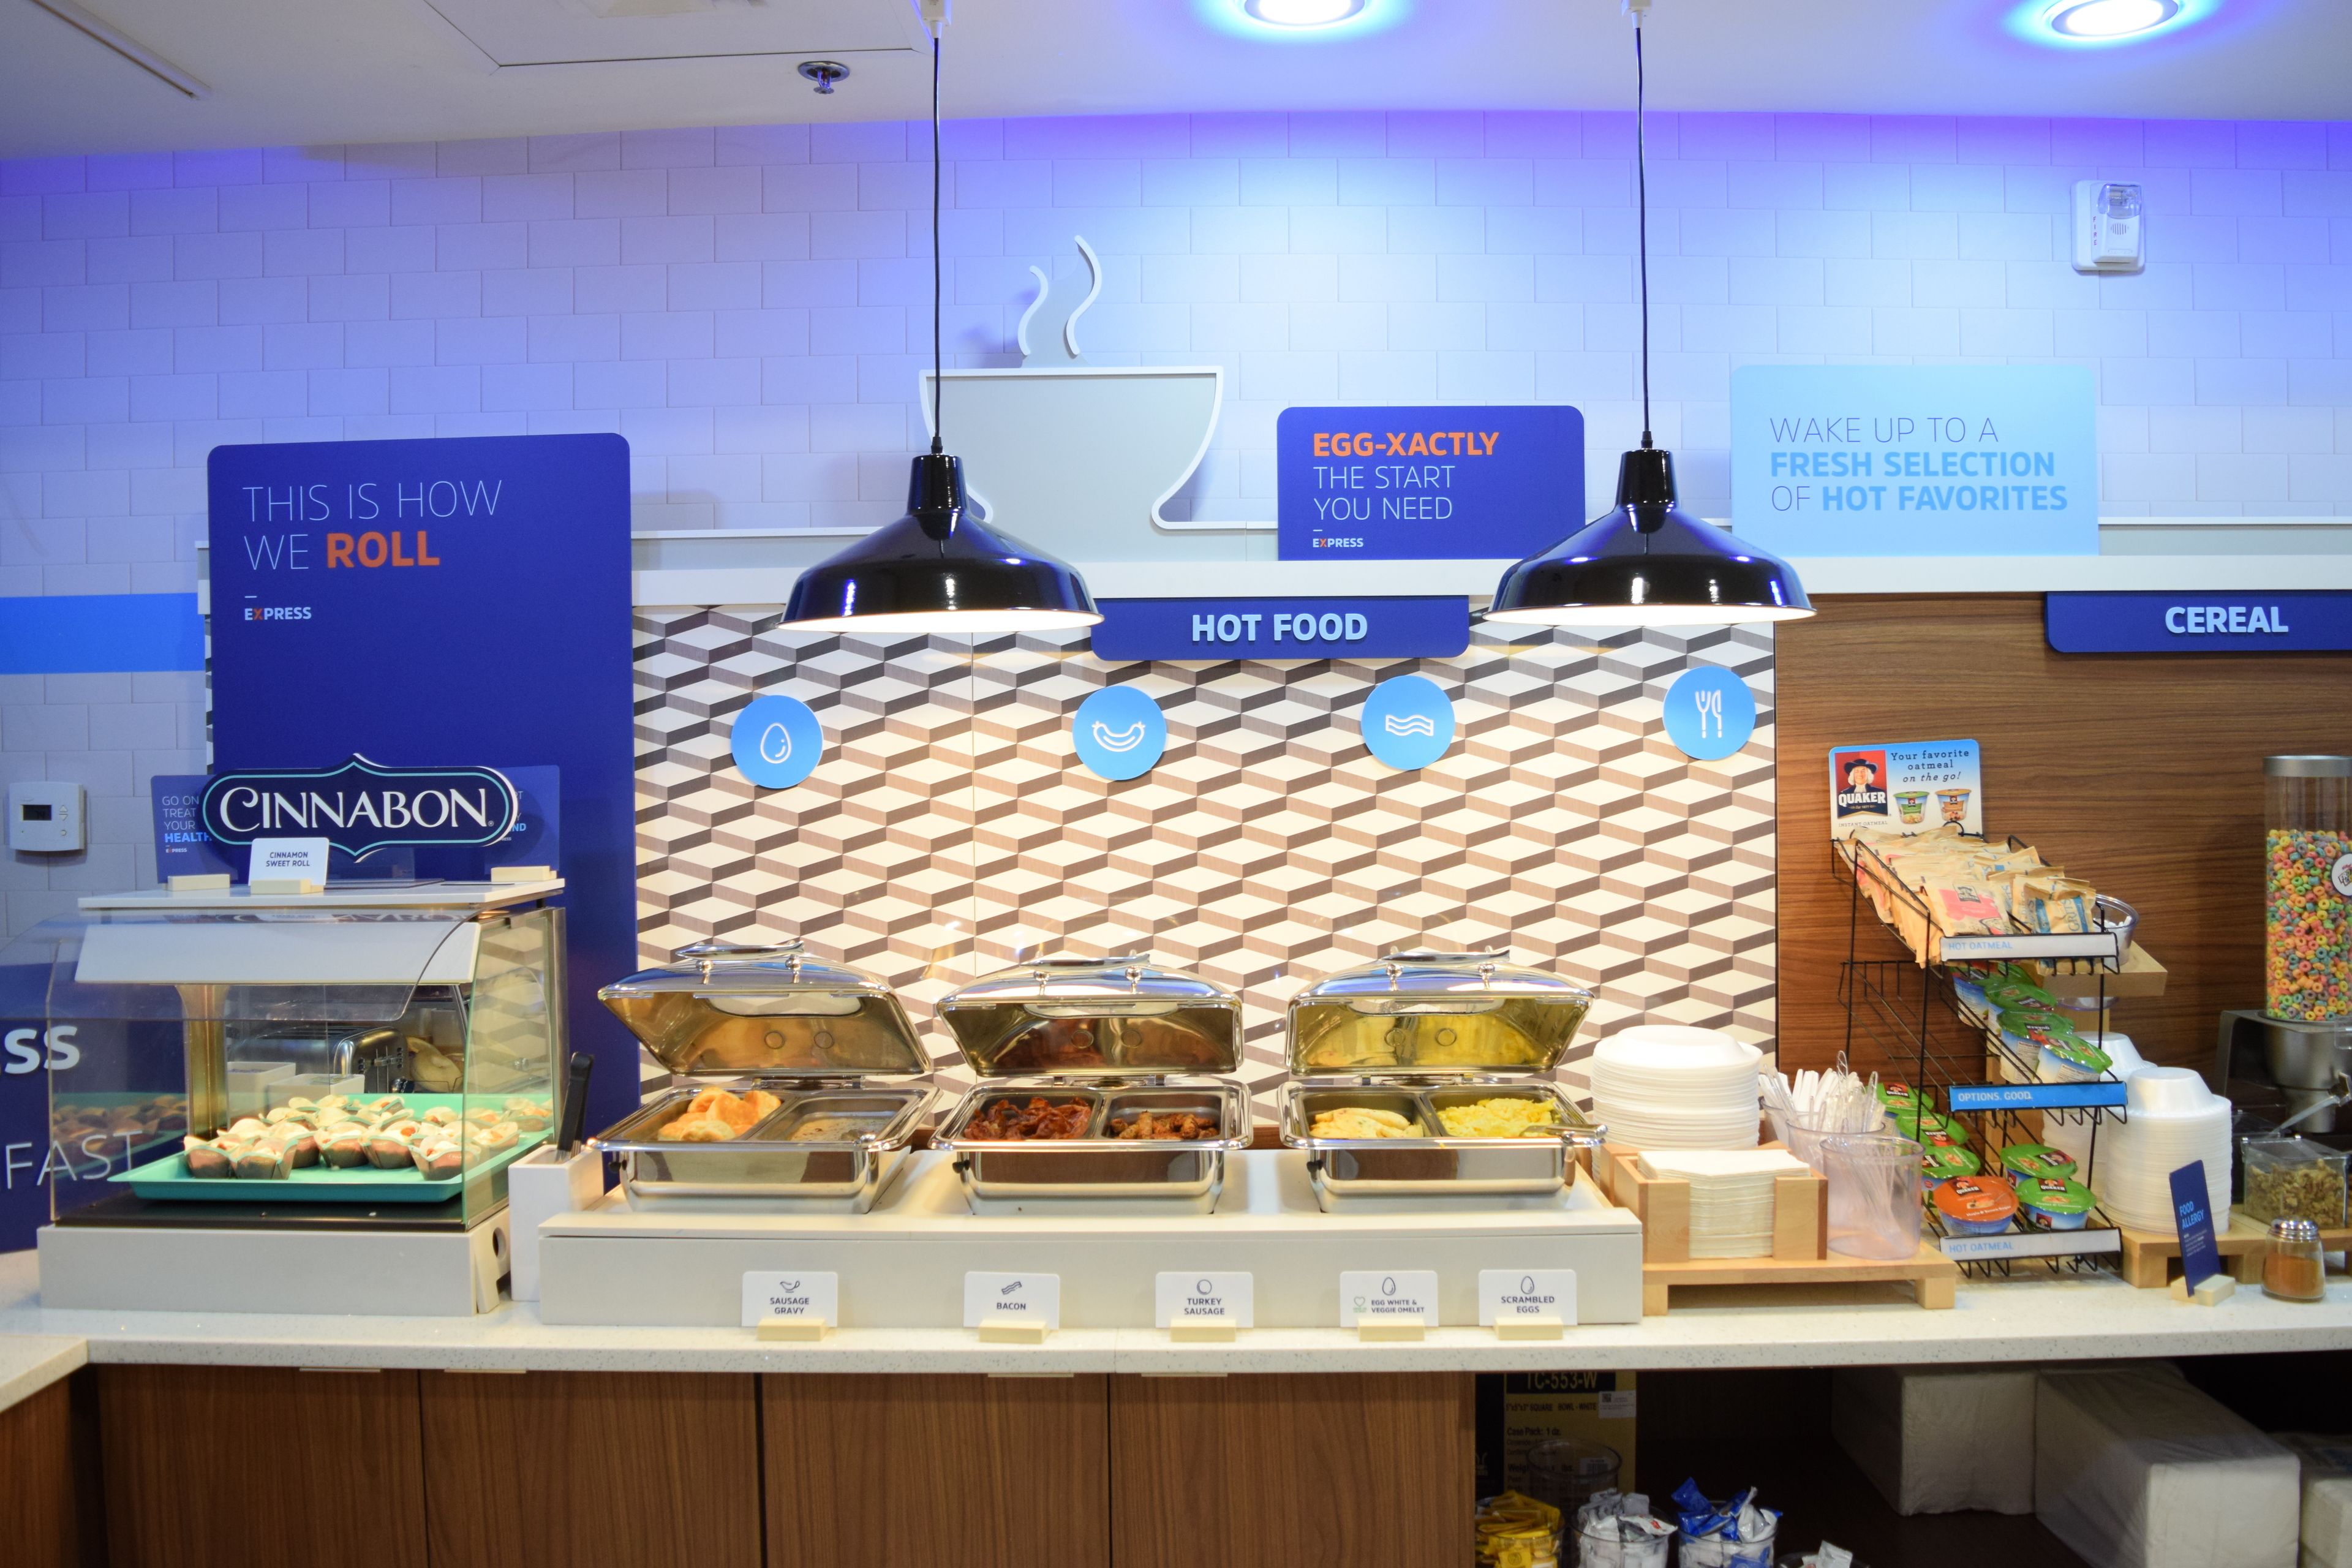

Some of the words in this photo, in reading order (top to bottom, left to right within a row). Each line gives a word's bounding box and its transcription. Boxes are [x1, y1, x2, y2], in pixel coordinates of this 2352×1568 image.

[1770, 417, 1861, 442] WAKE
[1874, 417, 1915, 442] UP
[1927, 417, 1966, 442] TO
[1978, 417, 1999, 442] A
[1313, 432, 1500, 457] EGG-XACTLY
[1770, 451, 1872, 477] FRESH
[1883, 451, 2055, 477] SELECTION
[1313, 466, 1365, 489] THE
[1375, 466, 1456, 489] START
[243, 484, 330, 522] THIS
[349, 483, 379, 519] IS
[398, 480, 502, 519] HOW
[1771, 486, 1811, 511] OF
[1822, 486, 1887, 511] HOT
[1899, 485, 2068, 511] FAVORITES
[1313, 497, 1370, 520] YOU
[1383, 497, 1453, 520] NEED
[244, 533, 309, 570] WE
[326, 530, 440, 568] ROLL
[1313, 538, 1364, 548] EXPRESS
[244, 606, 312, 621] EXPRESS
[2165, 606, 2289, 633] CEREAL
[1192, 614, 1262, 642] HOT
[1273, 613, 1367, 641] FOOD
[1891, 752, 1918, 761] Your
[1922, 750, 1970, 759] favorite
[1907, 760, 1954, 770] oatmeal
[1920, 772, 1939, 781] the
[1942, 771, 1961, 782] go!
[162, 796, 179, 806] GO
[183, 796, 199, 805] ON
[1838, 791, 1887, 807] QUAKER
[163, 808, 196, 818] TREAT
[220, 787, 488, 832] CINNABON
[164, 820, 195, 831] YOUR
[1948, 941, 1967, 950] HOT
[1969, 941, 2014, 949] OATMEAL
[1958, 1092, 2002, 1102] OPTIONS.
[6, 1130, 143, 1189] FAST
[2179, 1201, 2194, 1216] FOOD
[2182, 1209, 2204, 1230] ALLERGY
[1949, 1244, 1971, 1253] HOT
[1972, 1242, 2014, 1252] OATMEAL
